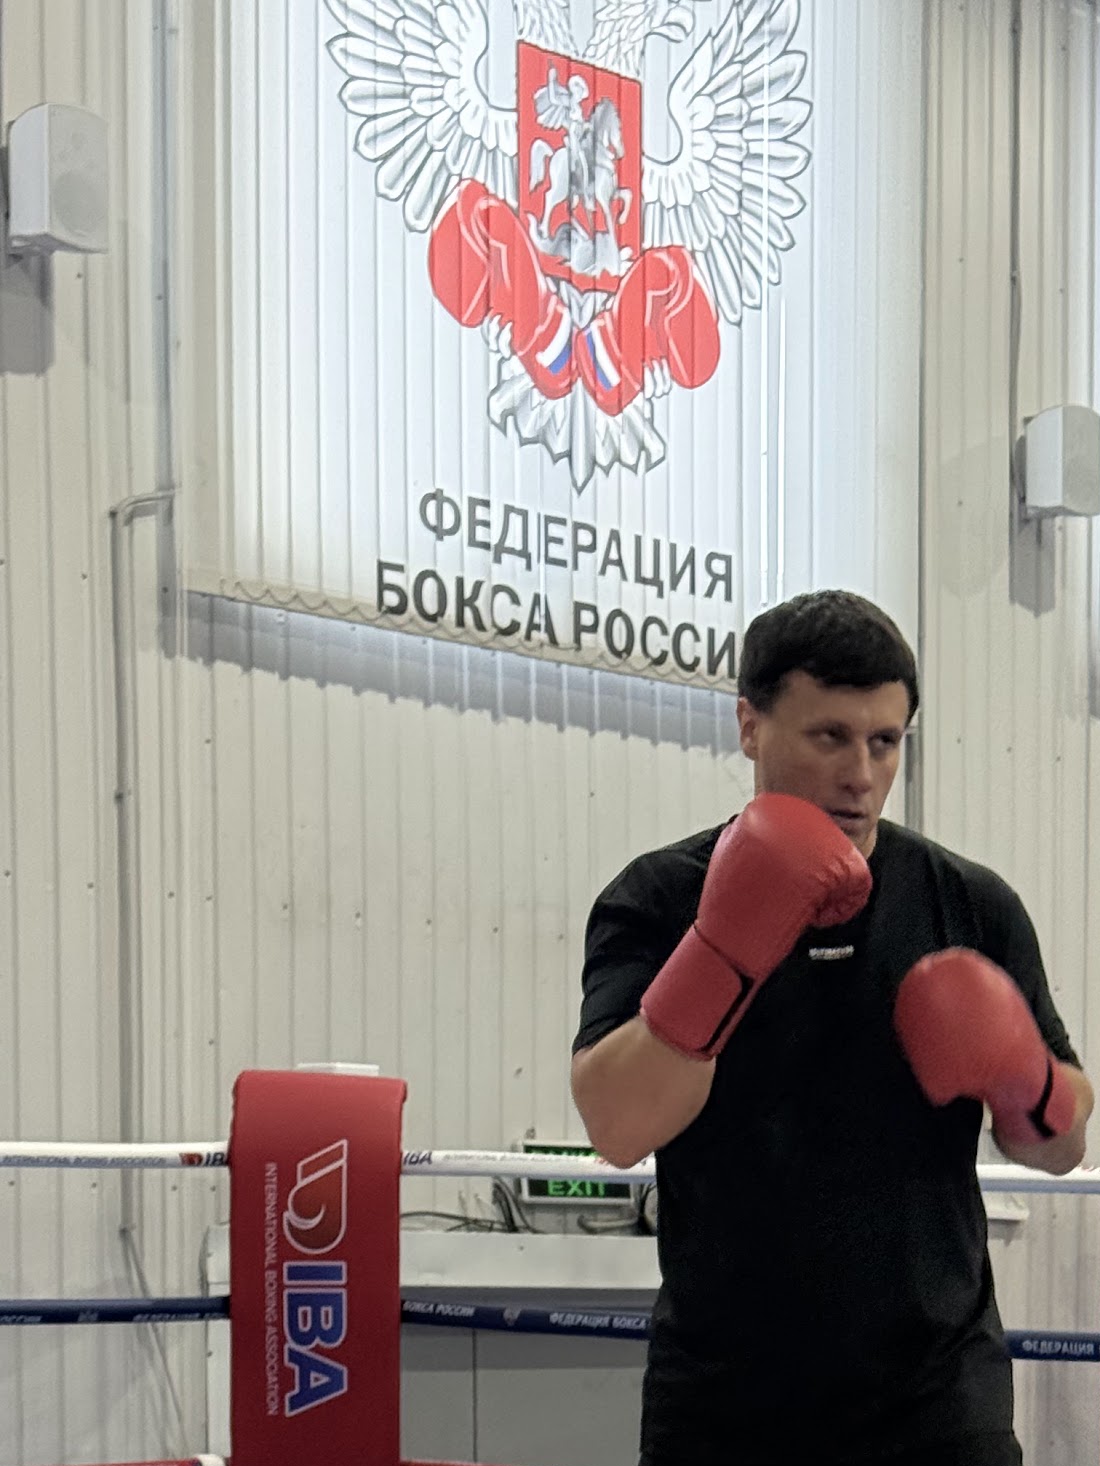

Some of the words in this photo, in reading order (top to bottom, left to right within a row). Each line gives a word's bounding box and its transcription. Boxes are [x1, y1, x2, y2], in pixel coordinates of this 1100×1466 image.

[419, 488, 733, 603] ФЕДЕРАЦИЯ
[376, 559, 559, 646] БОКСА
[572, 600, 736, 680] РОССИ
[205, 1152, 229, 1166] IB
[547, 1179, 605, 1196] EXIT
[264, 1162, 279, 1268] INTERNATIONAL
[265, 1270, 279, 1324] BOXING
[612, 1316, 647, 1330] БОКСА
[265, 1326, 280, 1416] ASSOCIATION
[283, 1260, 348, 1418] IBA
[1022, 1340, 1094, 1356] ФЕДЕРАЦИЯ
